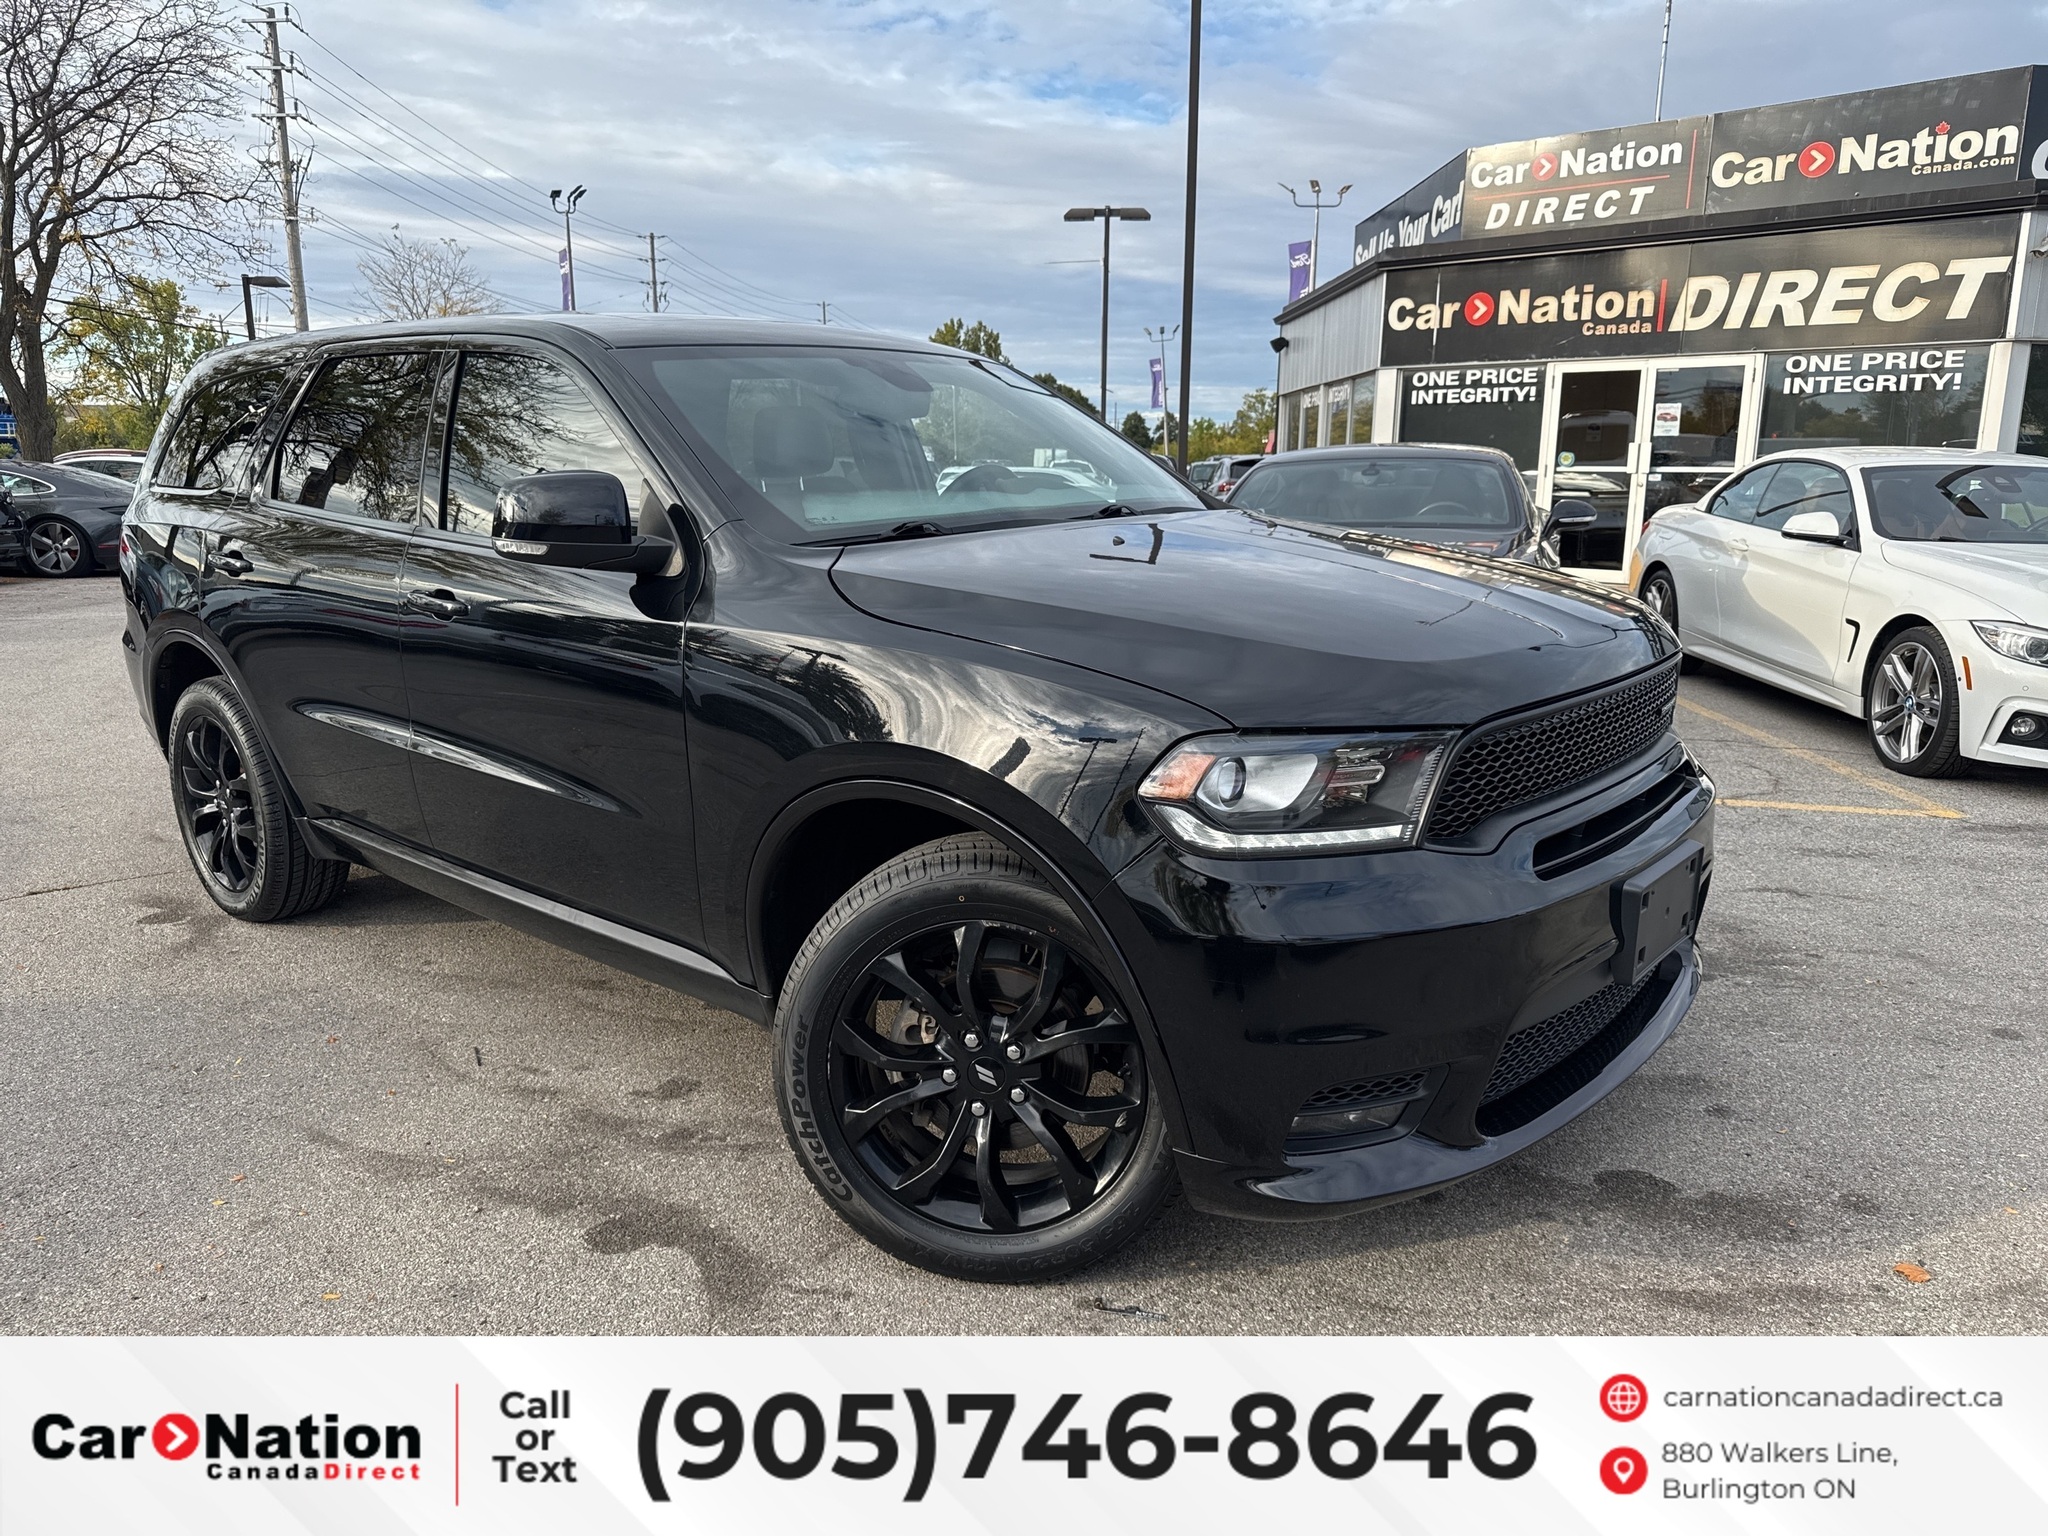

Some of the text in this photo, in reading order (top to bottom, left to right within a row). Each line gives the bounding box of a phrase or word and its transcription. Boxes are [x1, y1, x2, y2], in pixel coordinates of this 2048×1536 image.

[1471, 141, 1683, 189] Car Nation
[1711, 151, 1797, 188] Car
[1838, 122, 2019, 174] Nation
[1911, 155, 2015, 176] Canada.com
[1399, 215, 1430, 248] Your
[1431, 180, 1465, 238] Car!
[1484, 185, 1656, 230] DIRECT
[1387, 255, 2013, 332] Car Nation DIRECT
[1582, 320, 1652, 336] Canada
[1412, 367, 1538, 387] ONE PRICE
[1785, 349, 1967, 374] ONE PRICE
[1411, 386, 1537, 405] INTEGRITY!
[1783, 373, 1963, 394] INTEGRITY!
[791, 1015, 853, 1201] CatchPower
